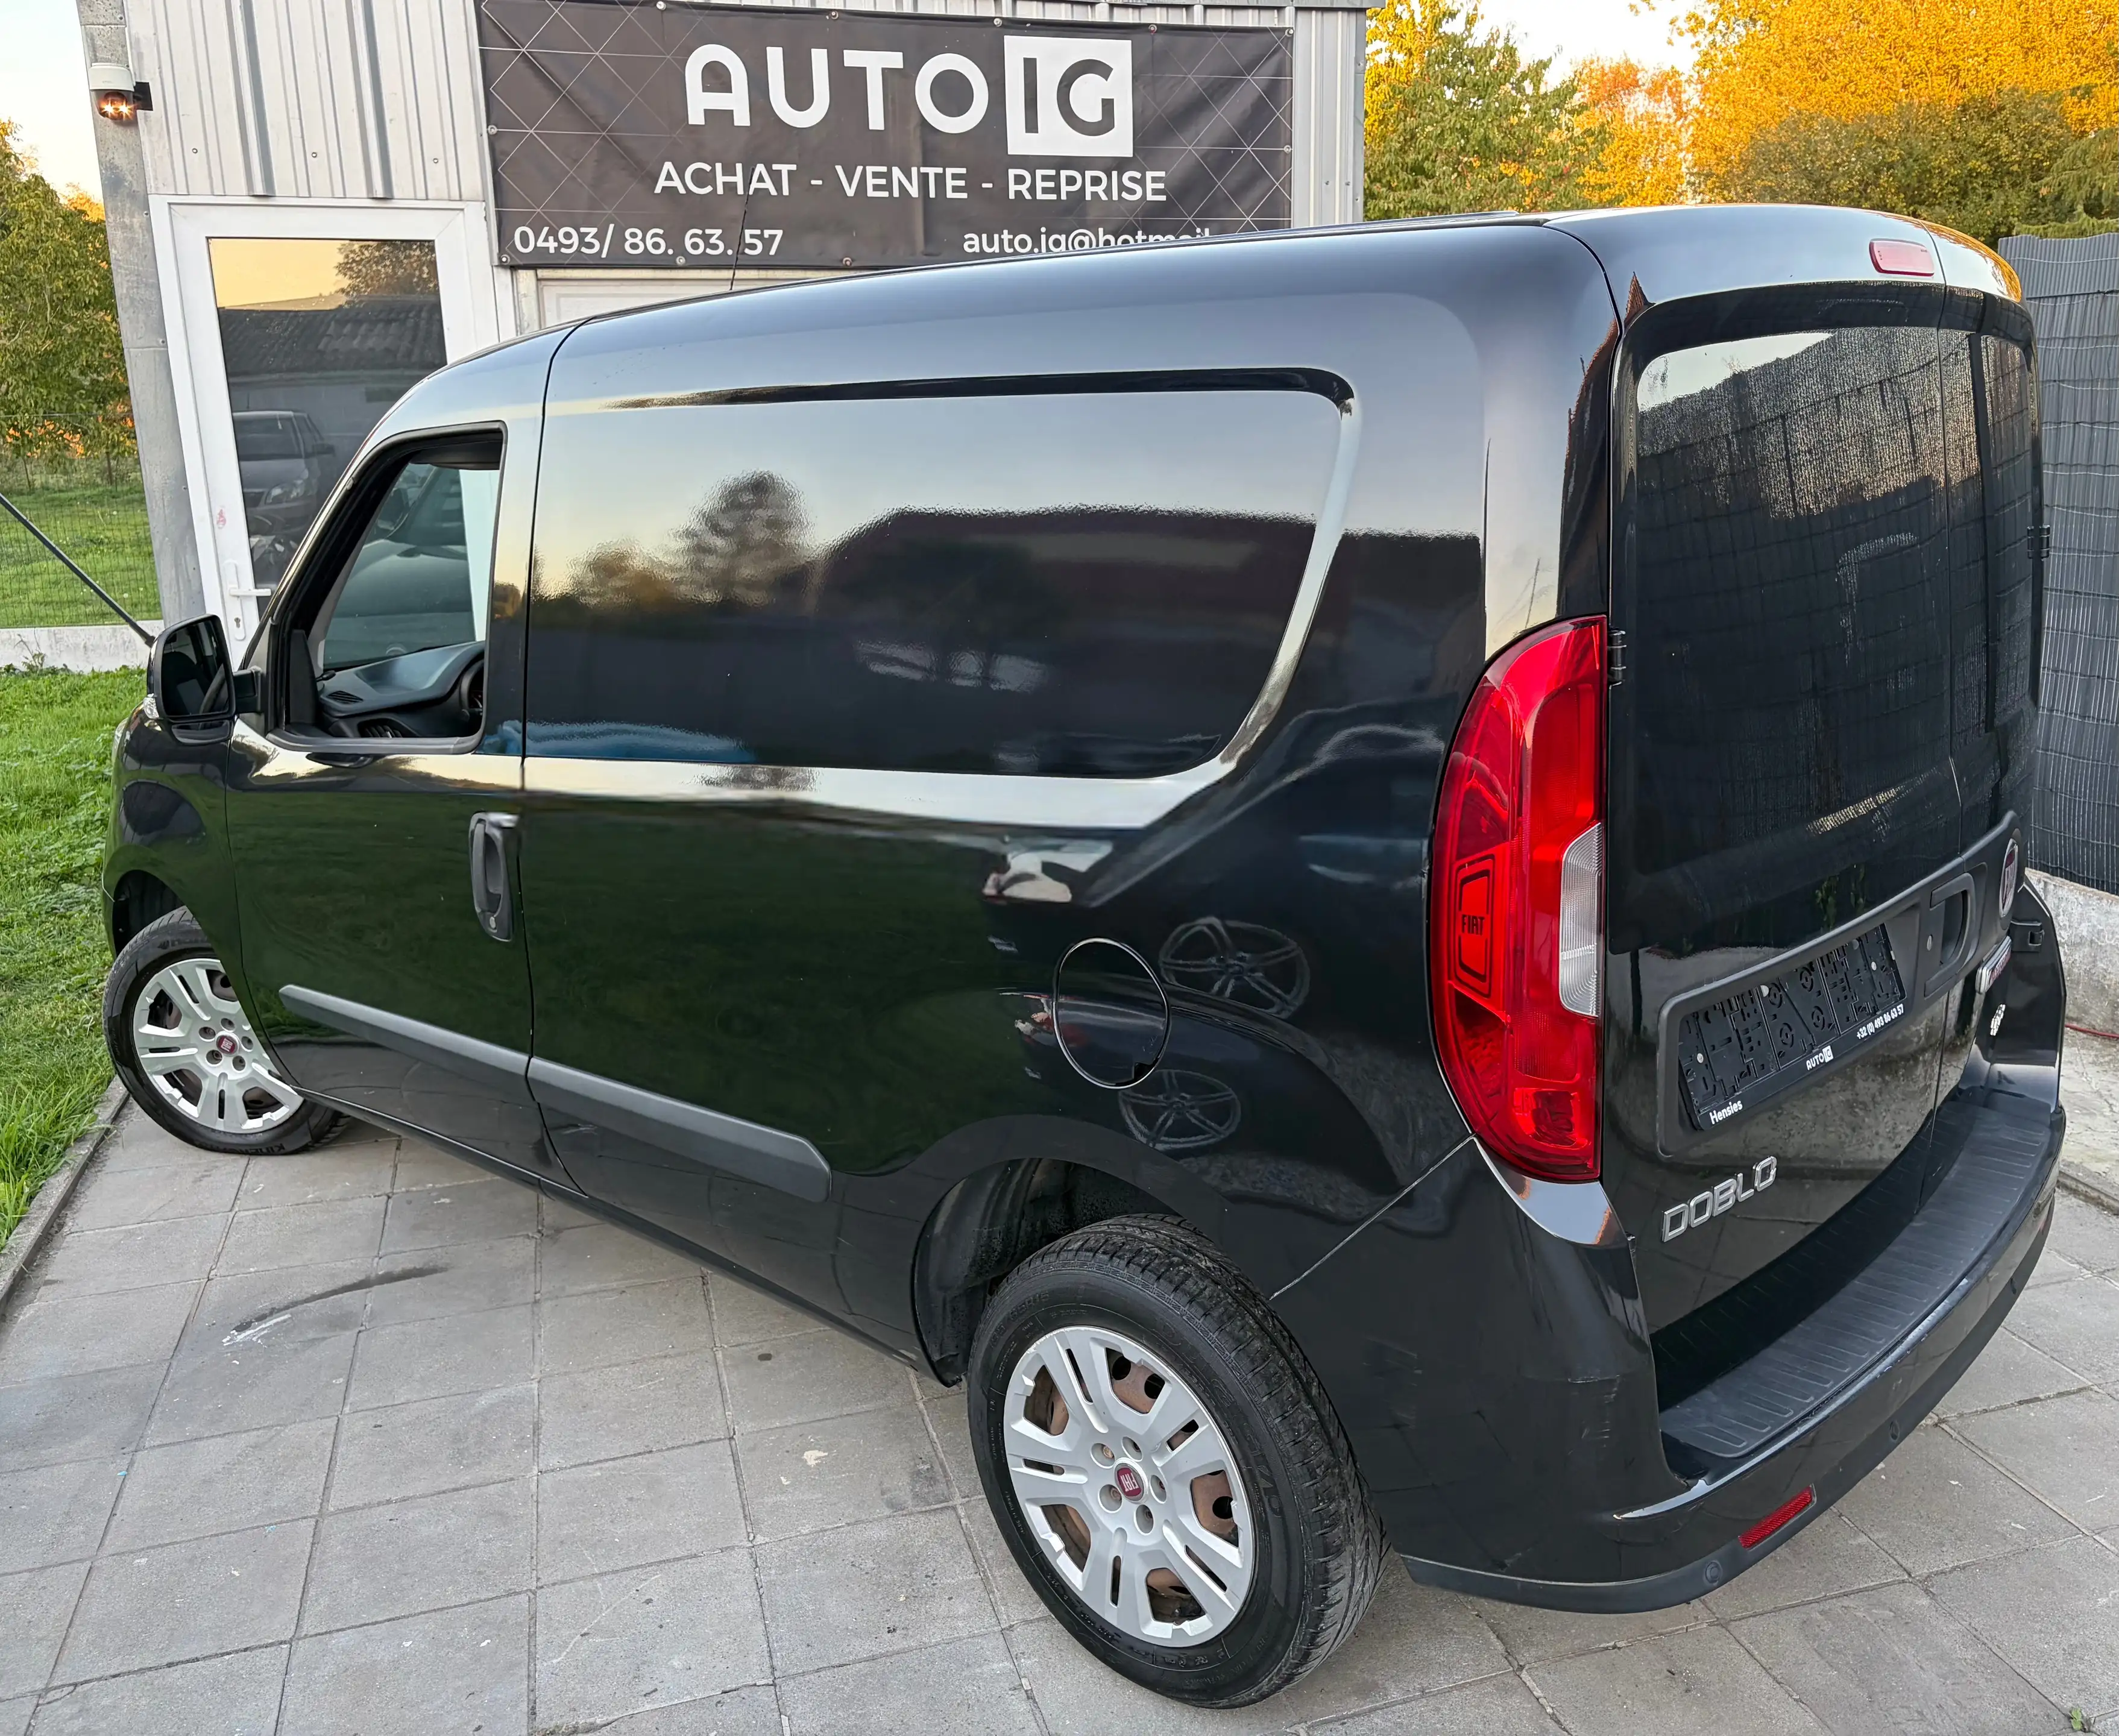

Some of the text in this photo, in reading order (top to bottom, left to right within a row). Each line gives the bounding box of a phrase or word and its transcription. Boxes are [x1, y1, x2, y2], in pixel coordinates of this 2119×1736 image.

[685, 43, 1116, 139] AUTO IG
[654, 161, 797, 196] ACHAT
[834, 165, 968, 199] VENTE
[1008, 168, 1167, 201] REPRISE
[514, 223, 783, 259] 0493/ 86. 63. 57
[963, 227, 1210, 254] auto.ig@hot
[1461, 914, 1485, 935] FIAT
[1874, 1016, 1884, 1029] 493
[1883, 1011, 1891, 1024] 86
[1891, 1007, 1898, 1019] 63
[1897, 1003, 1904, 1015] 57
[1806, 1052, 1824, 1071] AUTO
[1709, 1100, 1743, 1125] Hensies
[1661, 1156, 1777, 1243] DOBLO
[1120, 1471, 1139, 1492] FIAT
